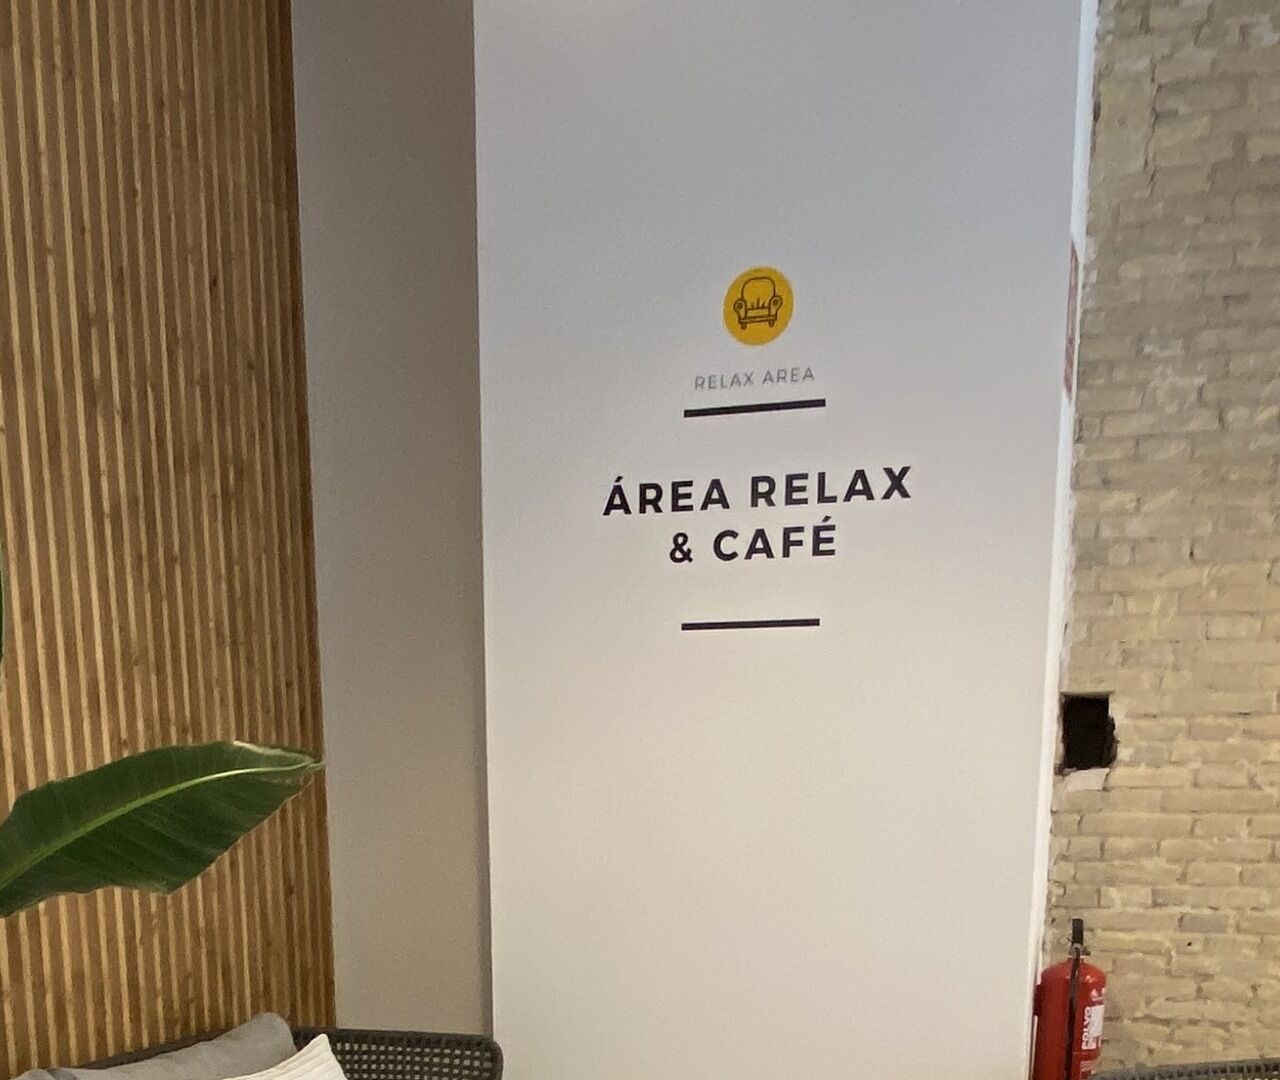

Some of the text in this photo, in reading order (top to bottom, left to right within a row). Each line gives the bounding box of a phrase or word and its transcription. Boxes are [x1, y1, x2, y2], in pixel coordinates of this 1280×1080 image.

[694, 366, 815, 391] RELAX AREA
[602, 465, 912, 517] ÁREA RELAX
[669, 515, 837, 564] & CAFÉ
[1081, 1005, 1092, 1050] POLVO
